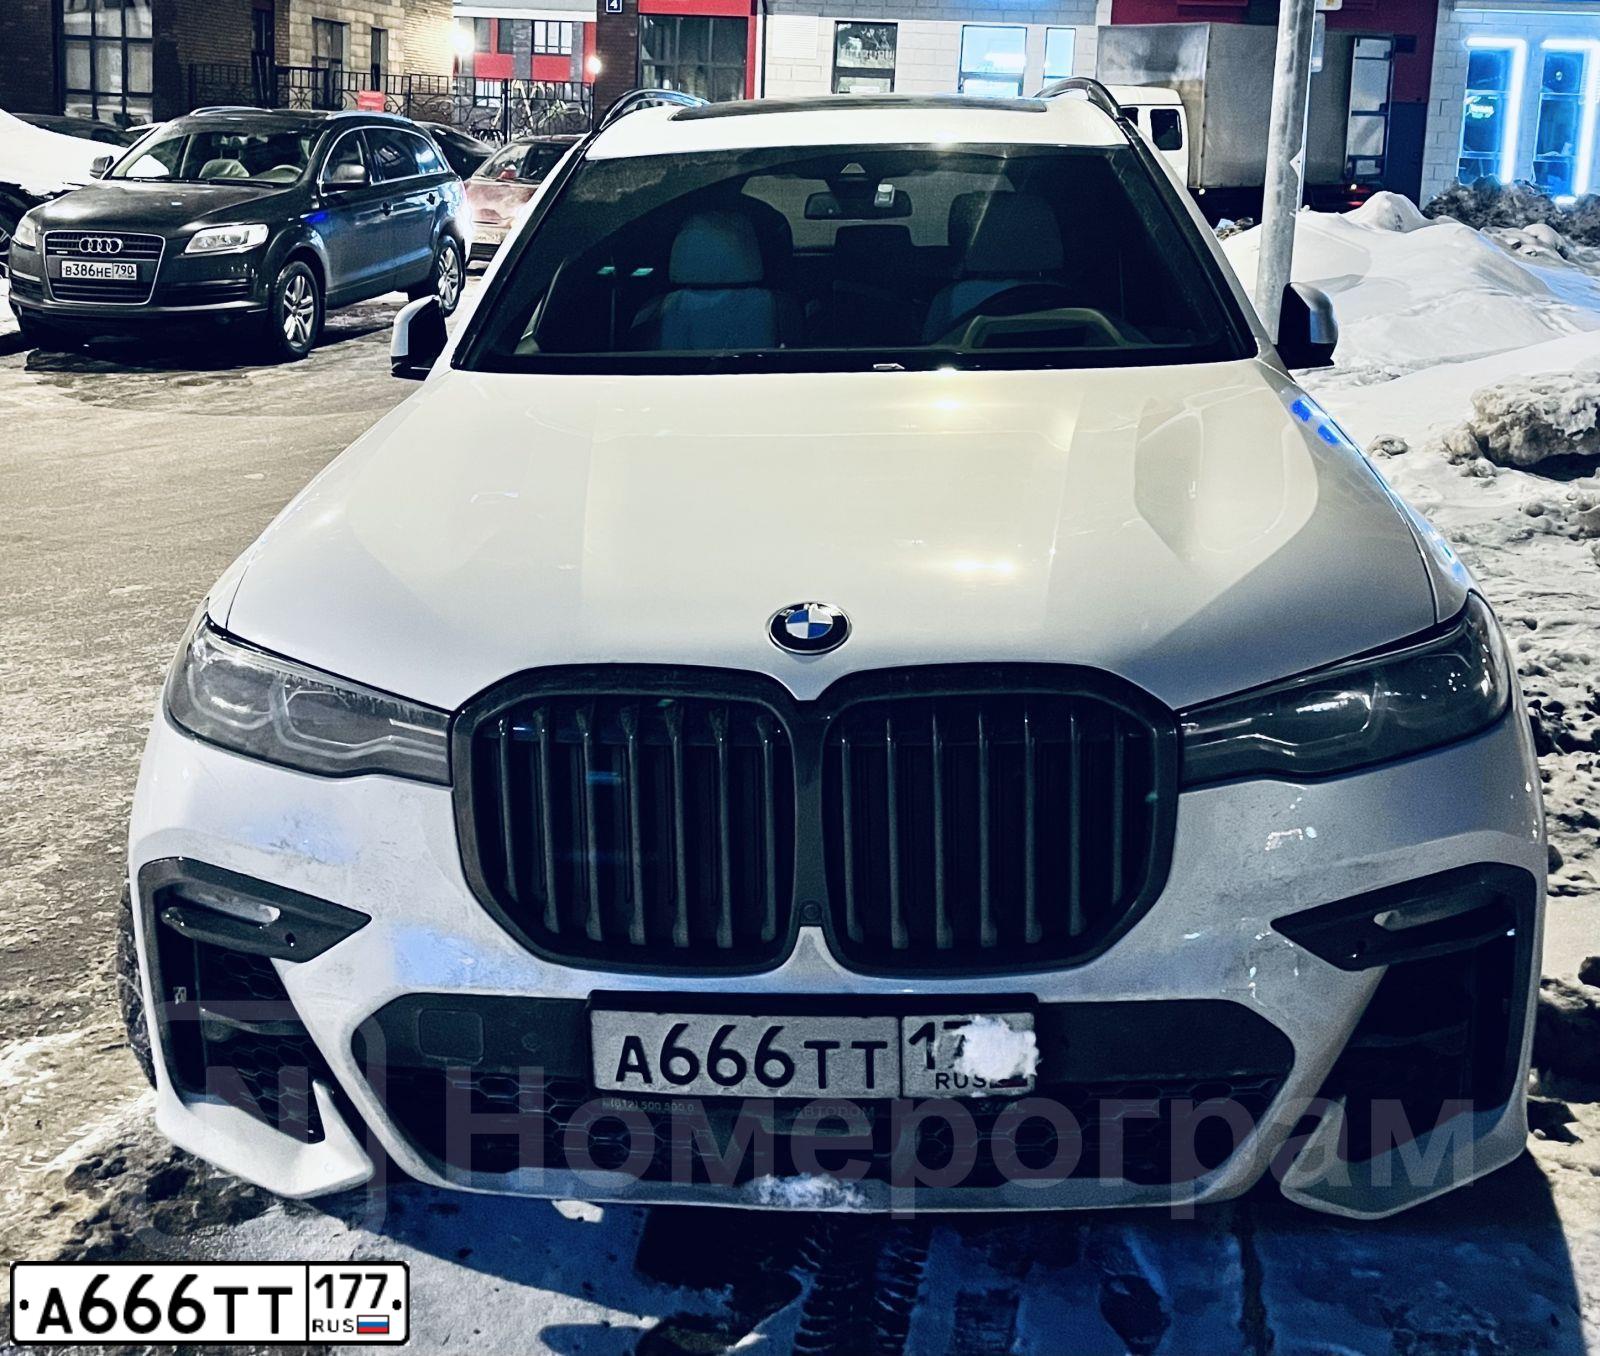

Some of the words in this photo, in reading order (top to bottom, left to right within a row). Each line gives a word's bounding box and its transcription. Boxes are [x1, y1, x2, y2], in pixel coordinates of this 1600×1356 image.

[609, 0, 618, 9] 4
[65, 263, 111, 278] В386НЕ
[114, 264, 133, 275] 790
[615, 1022, 888, 1090] А666ТТ
[936, 1072, 987, 1090] RUS
